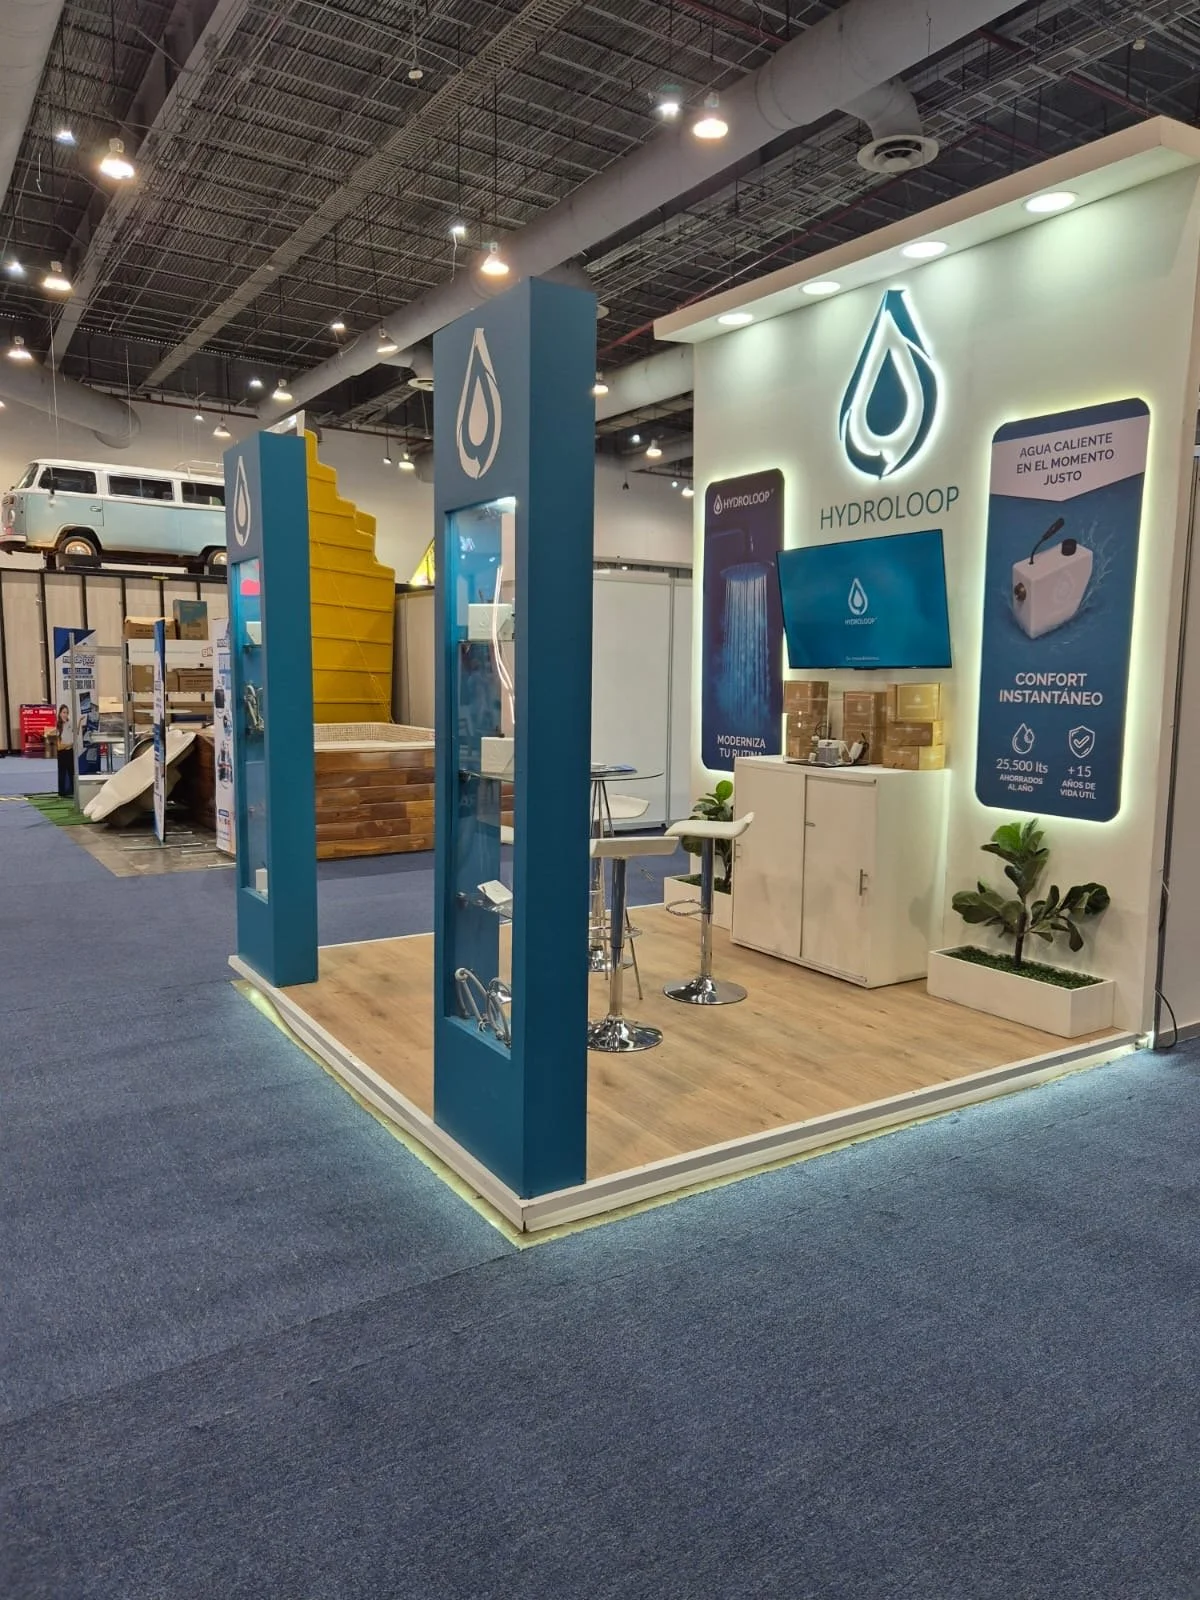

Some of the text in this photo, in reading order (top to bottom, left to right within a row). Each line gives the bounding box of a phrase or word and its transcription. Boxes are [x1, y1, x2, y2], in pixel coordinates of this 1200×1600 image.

[1020, 432, 1113, 458] AGUA CALIENTE
[1016, 449, 1115, 474] EN EL MOMENTO
[1043, 470, 1082, 486] JUSTO
[723, 491, 770, 509] HYDROLOOP
[820, 486, 960, 530] HYDROLOOP
[1015, 672, 1088, 687] CONFORT
[999, 687, 1104, 706] INSTANTÁNEO
[717, 734, 767, 749] MODERNIZA
[719, 747, 731, 758] TU
[999, 774, 1044, 785] AHORRADOS
[1061, 778, 1097, 791] AÑOS DE
[1007, 783, 1034, 792] AL AÑO
[1059, 788, 1079, 798] VIDA
